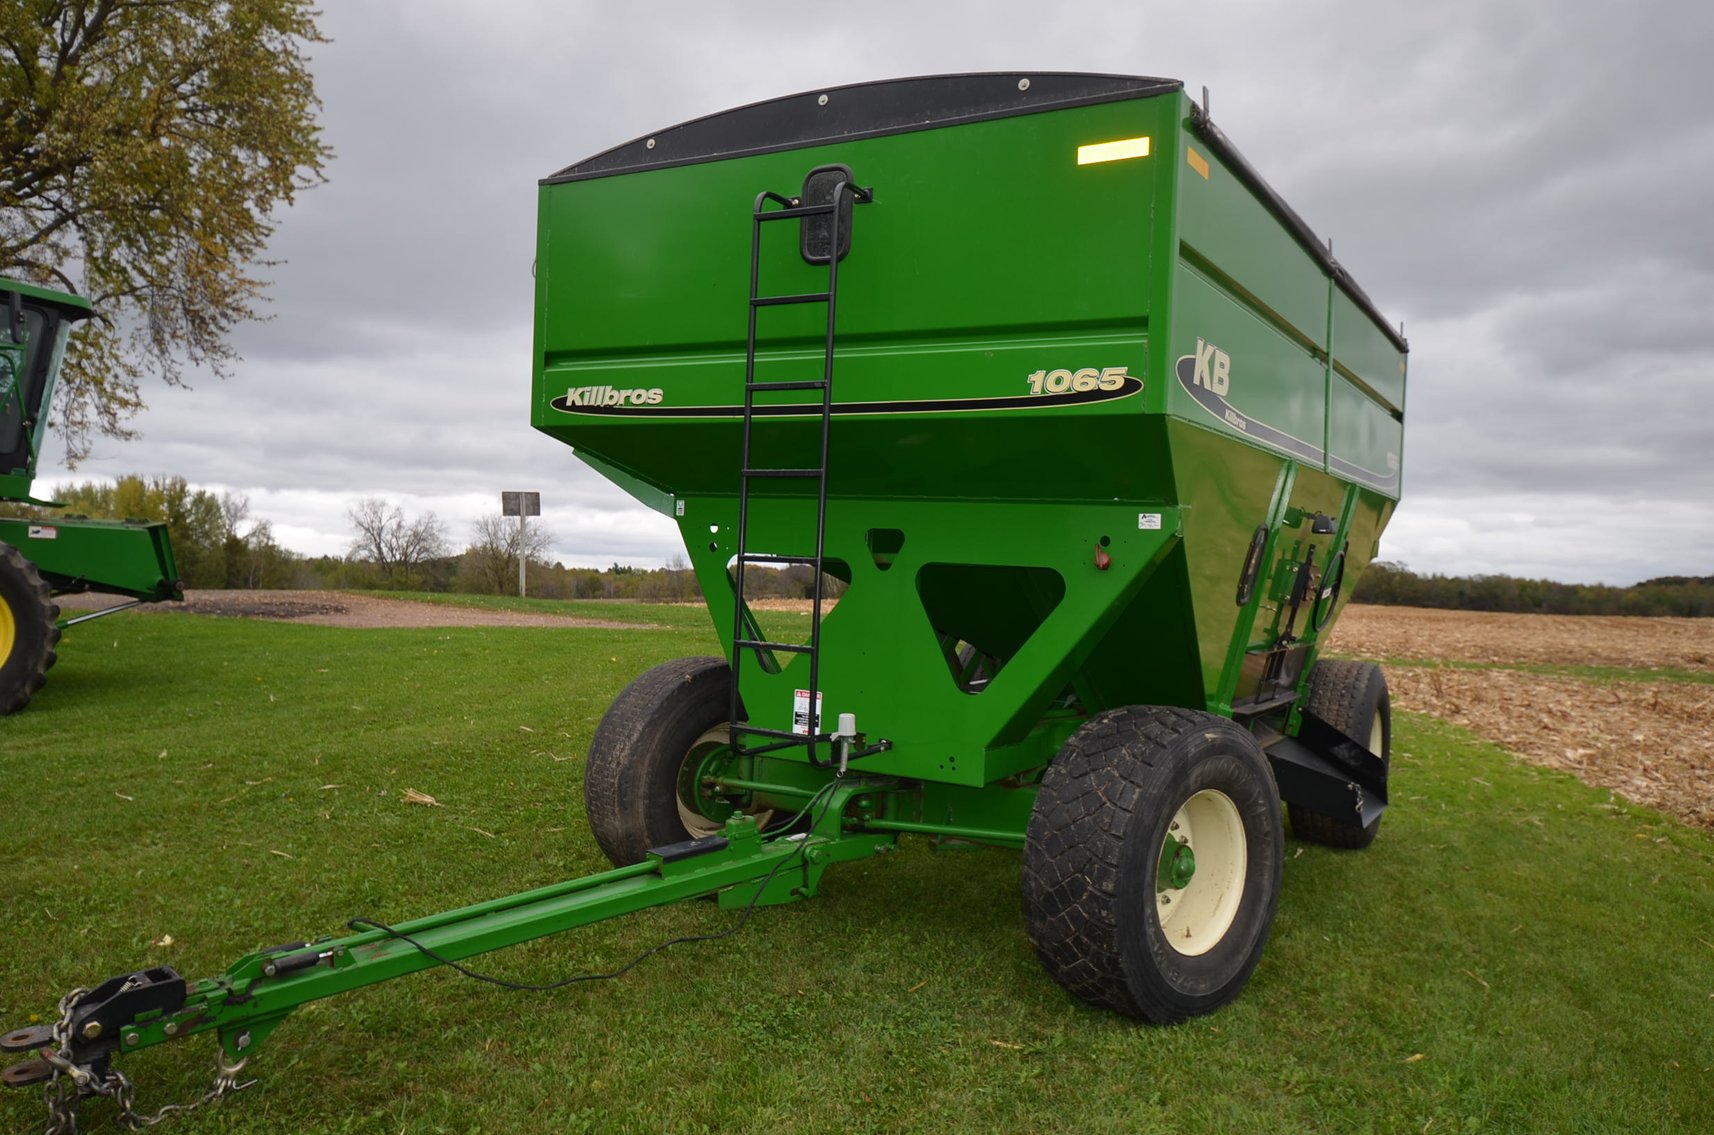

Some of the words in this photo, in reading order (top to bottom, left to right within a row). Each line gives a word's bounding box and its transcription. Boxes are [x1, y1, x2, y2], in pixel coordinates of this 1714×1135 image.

[1027, 366, 1129, 395] 1065
[1193, 336, 1230, 397] KB
[566, 385, 664, 407] Killbros
